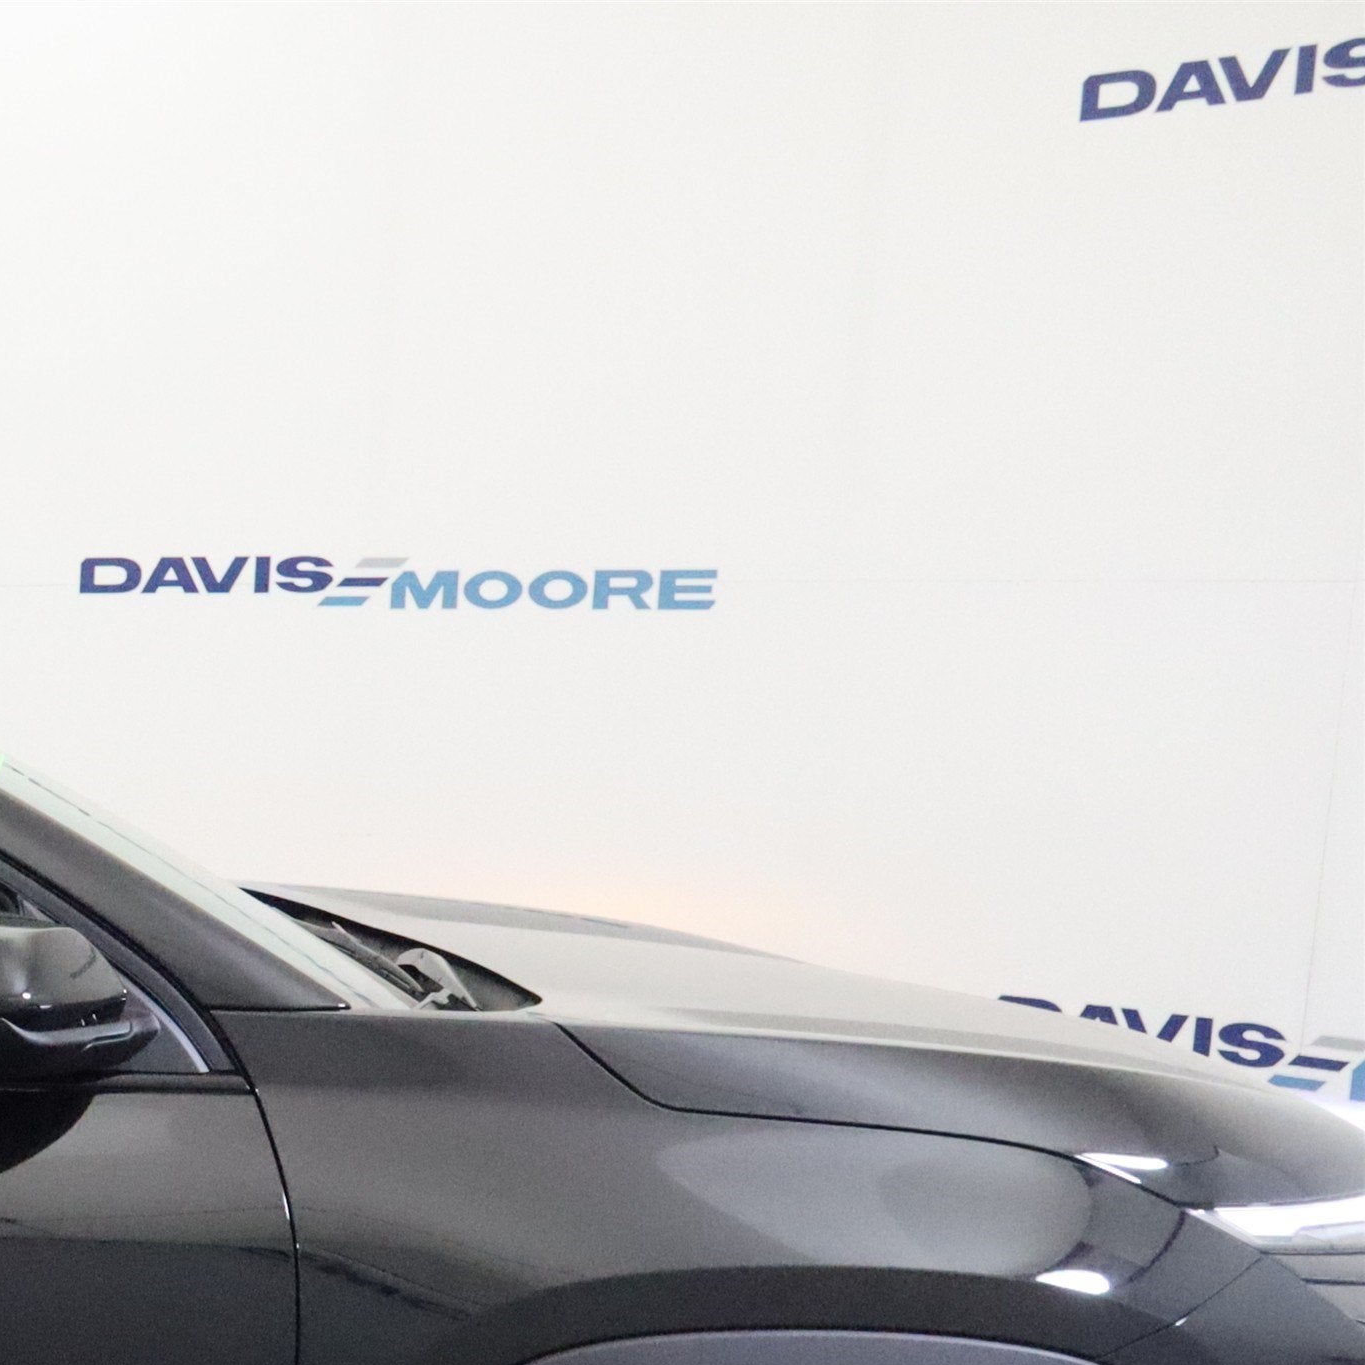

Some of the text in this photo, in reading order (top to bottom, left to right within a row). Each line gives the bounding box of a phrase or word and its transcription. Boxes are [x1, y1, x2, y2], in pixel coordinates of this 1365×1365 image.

[1078, 36, 1364, 123] DAVIS
[78, 555, 718, 611] DAVIS MOORE
[998, 994, 1287, 1068] VIS
